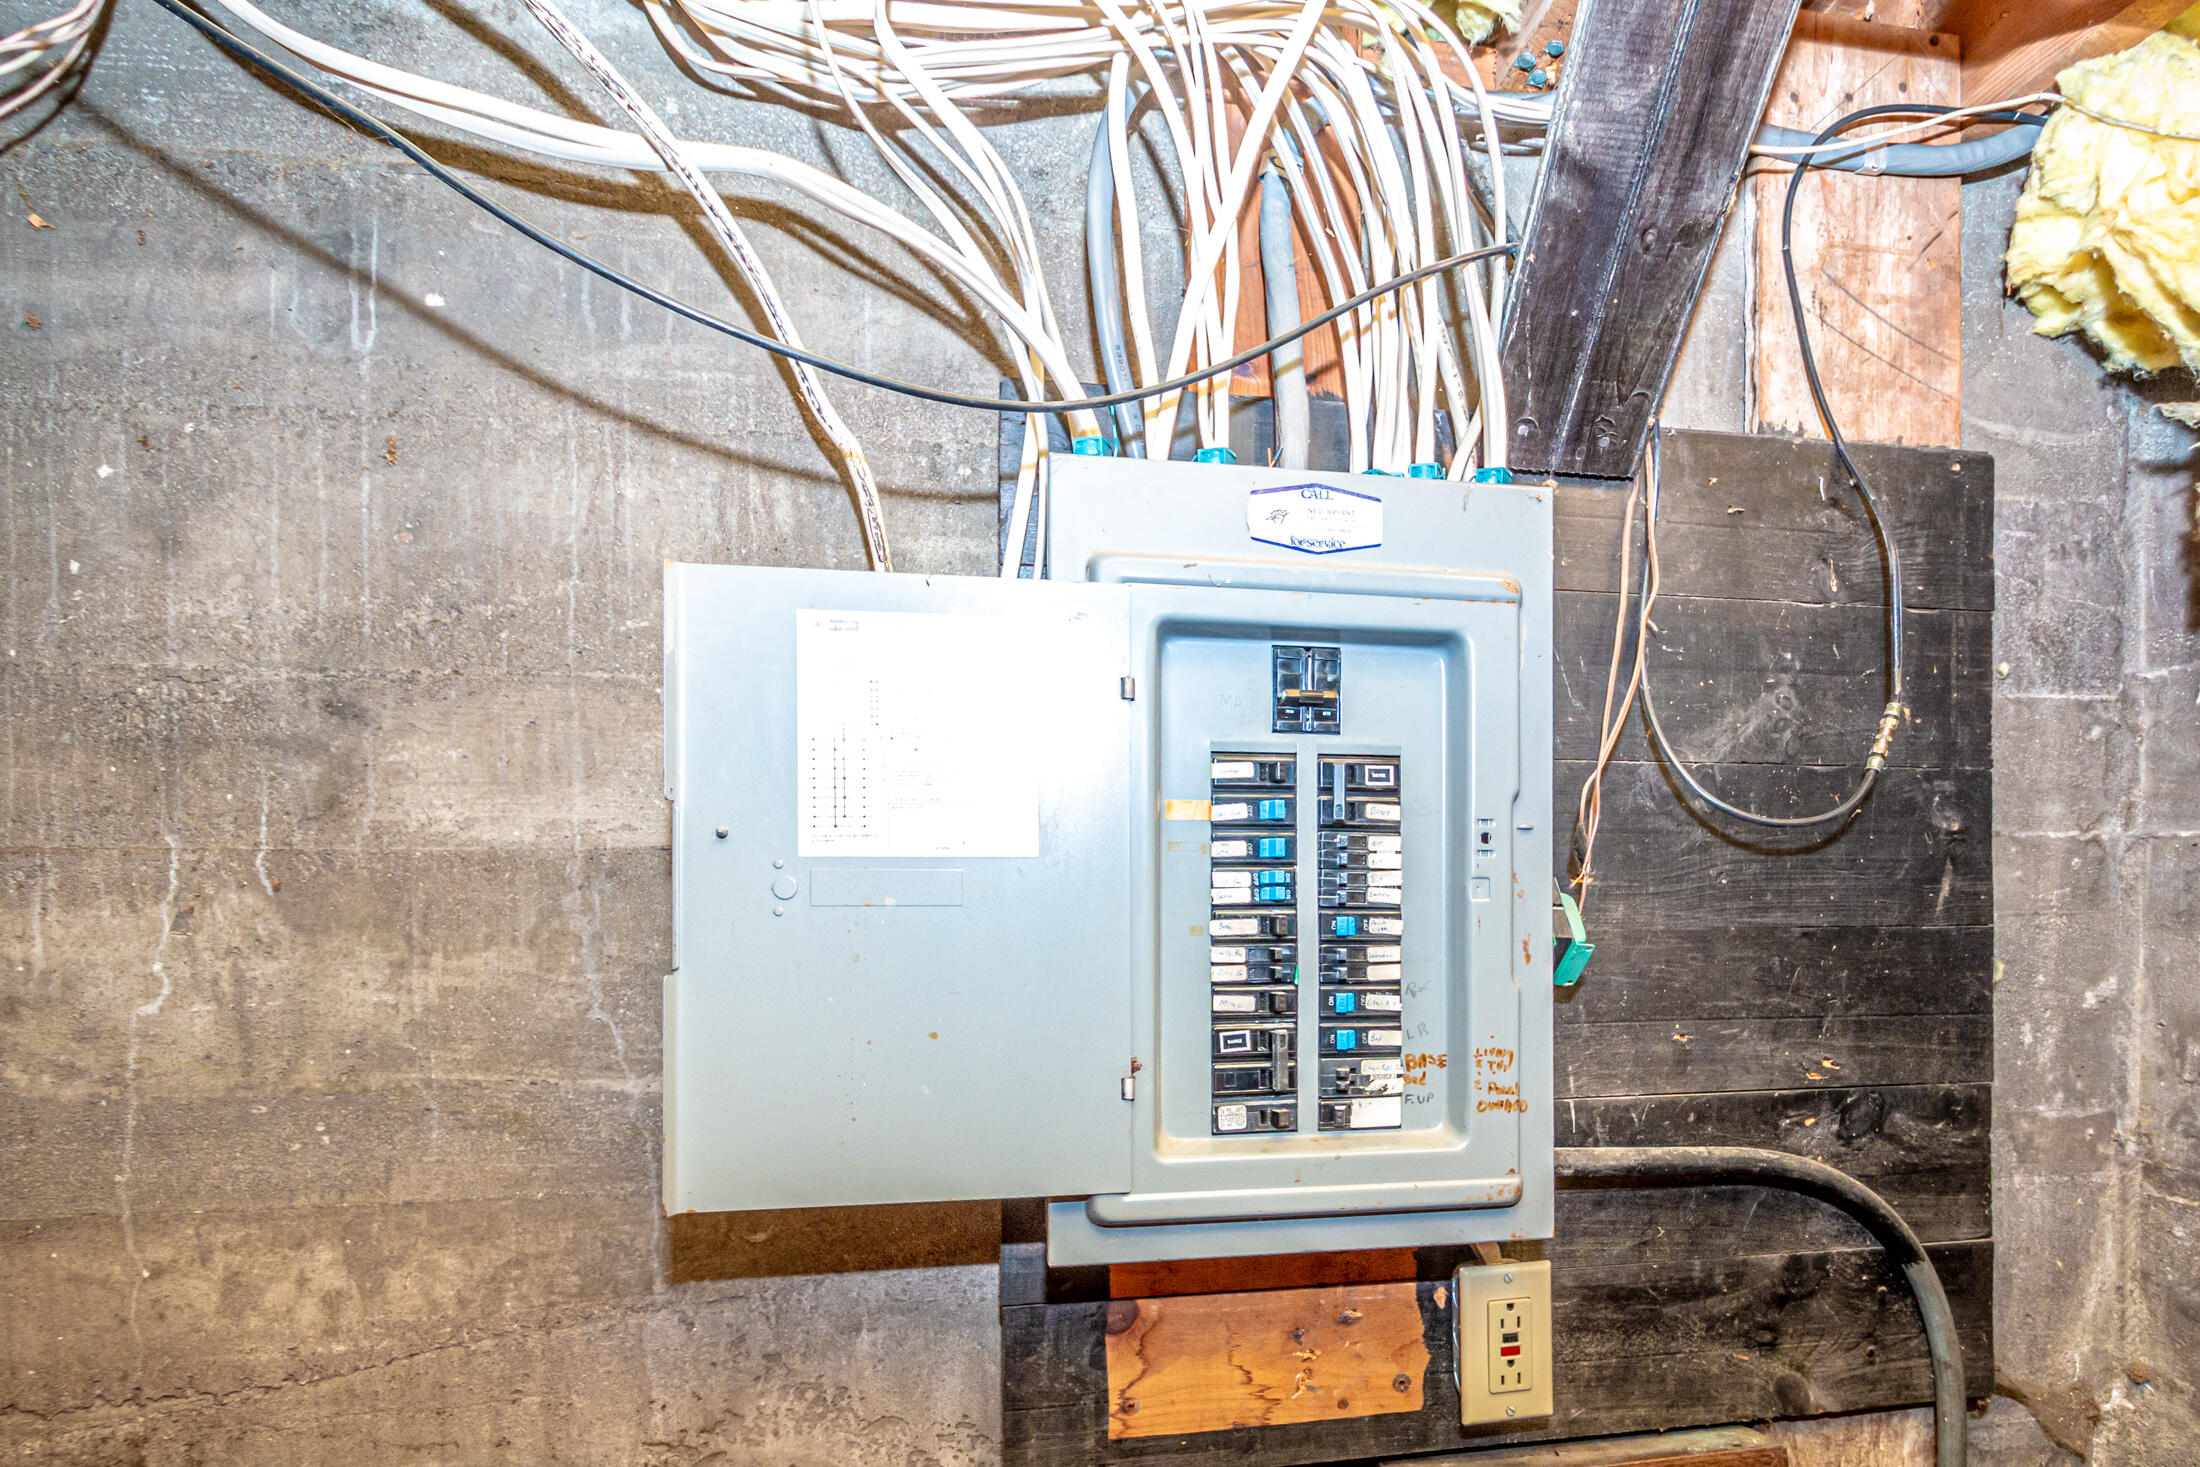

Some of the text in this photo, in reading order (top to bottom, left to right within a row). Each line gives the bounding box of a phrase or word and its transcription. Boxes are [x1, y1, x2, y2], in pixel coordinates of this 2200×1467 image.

[1301, 489, 1334, 500] CALL
[1286, 889, 1291, 899] ON
[1331, 920, 1336, 930] ON
[1329, 996, 1334, 1006] ON
[1330, 1034, 1336, 1044] ON
